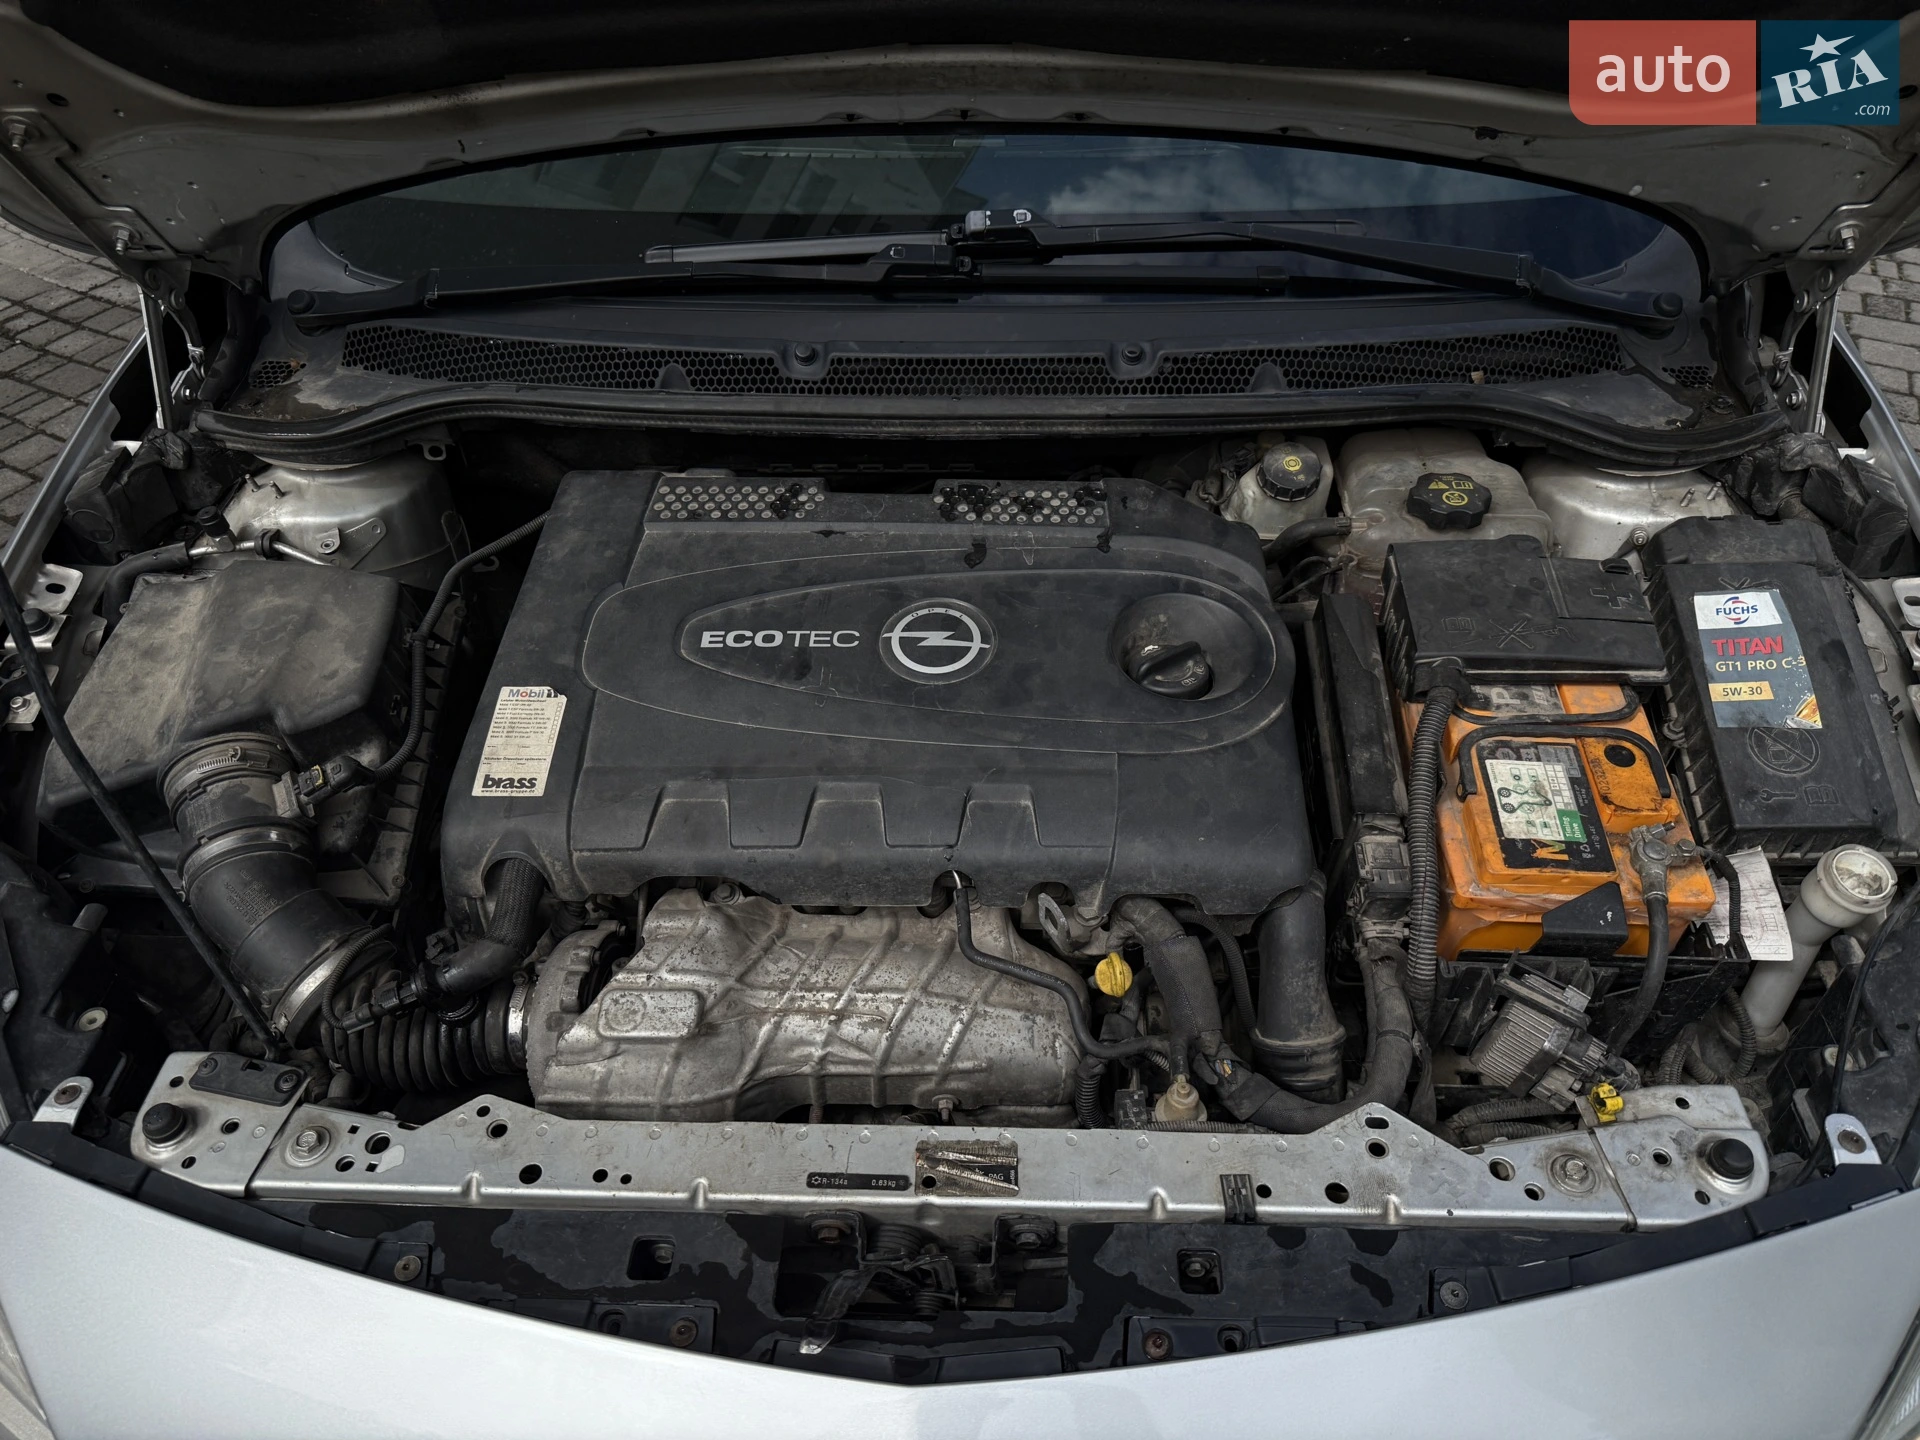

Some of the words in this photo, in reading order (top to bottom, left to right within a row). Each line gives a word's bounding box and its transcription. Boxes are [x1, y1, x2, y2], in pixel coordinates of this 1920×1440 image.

[1715, 604, 1759, 617] FUCHS
[699, 630, 861, 649] ECOTEC
[1711, 635, 1785, 657] TITAN
[1714, 660, 1742, 673] GT1
[1747, 659, 1778, 672] PRO
[507, 688, 546, 699] Mobil
[1721, 686, 1763, 698] 5W-30
[481, 774, 538, 790] brass
[1562, 816, 1572, 838] Timing
[1572, 823, 1582, 838] Drive
[821, 1176, 848, 1185] R-134a
